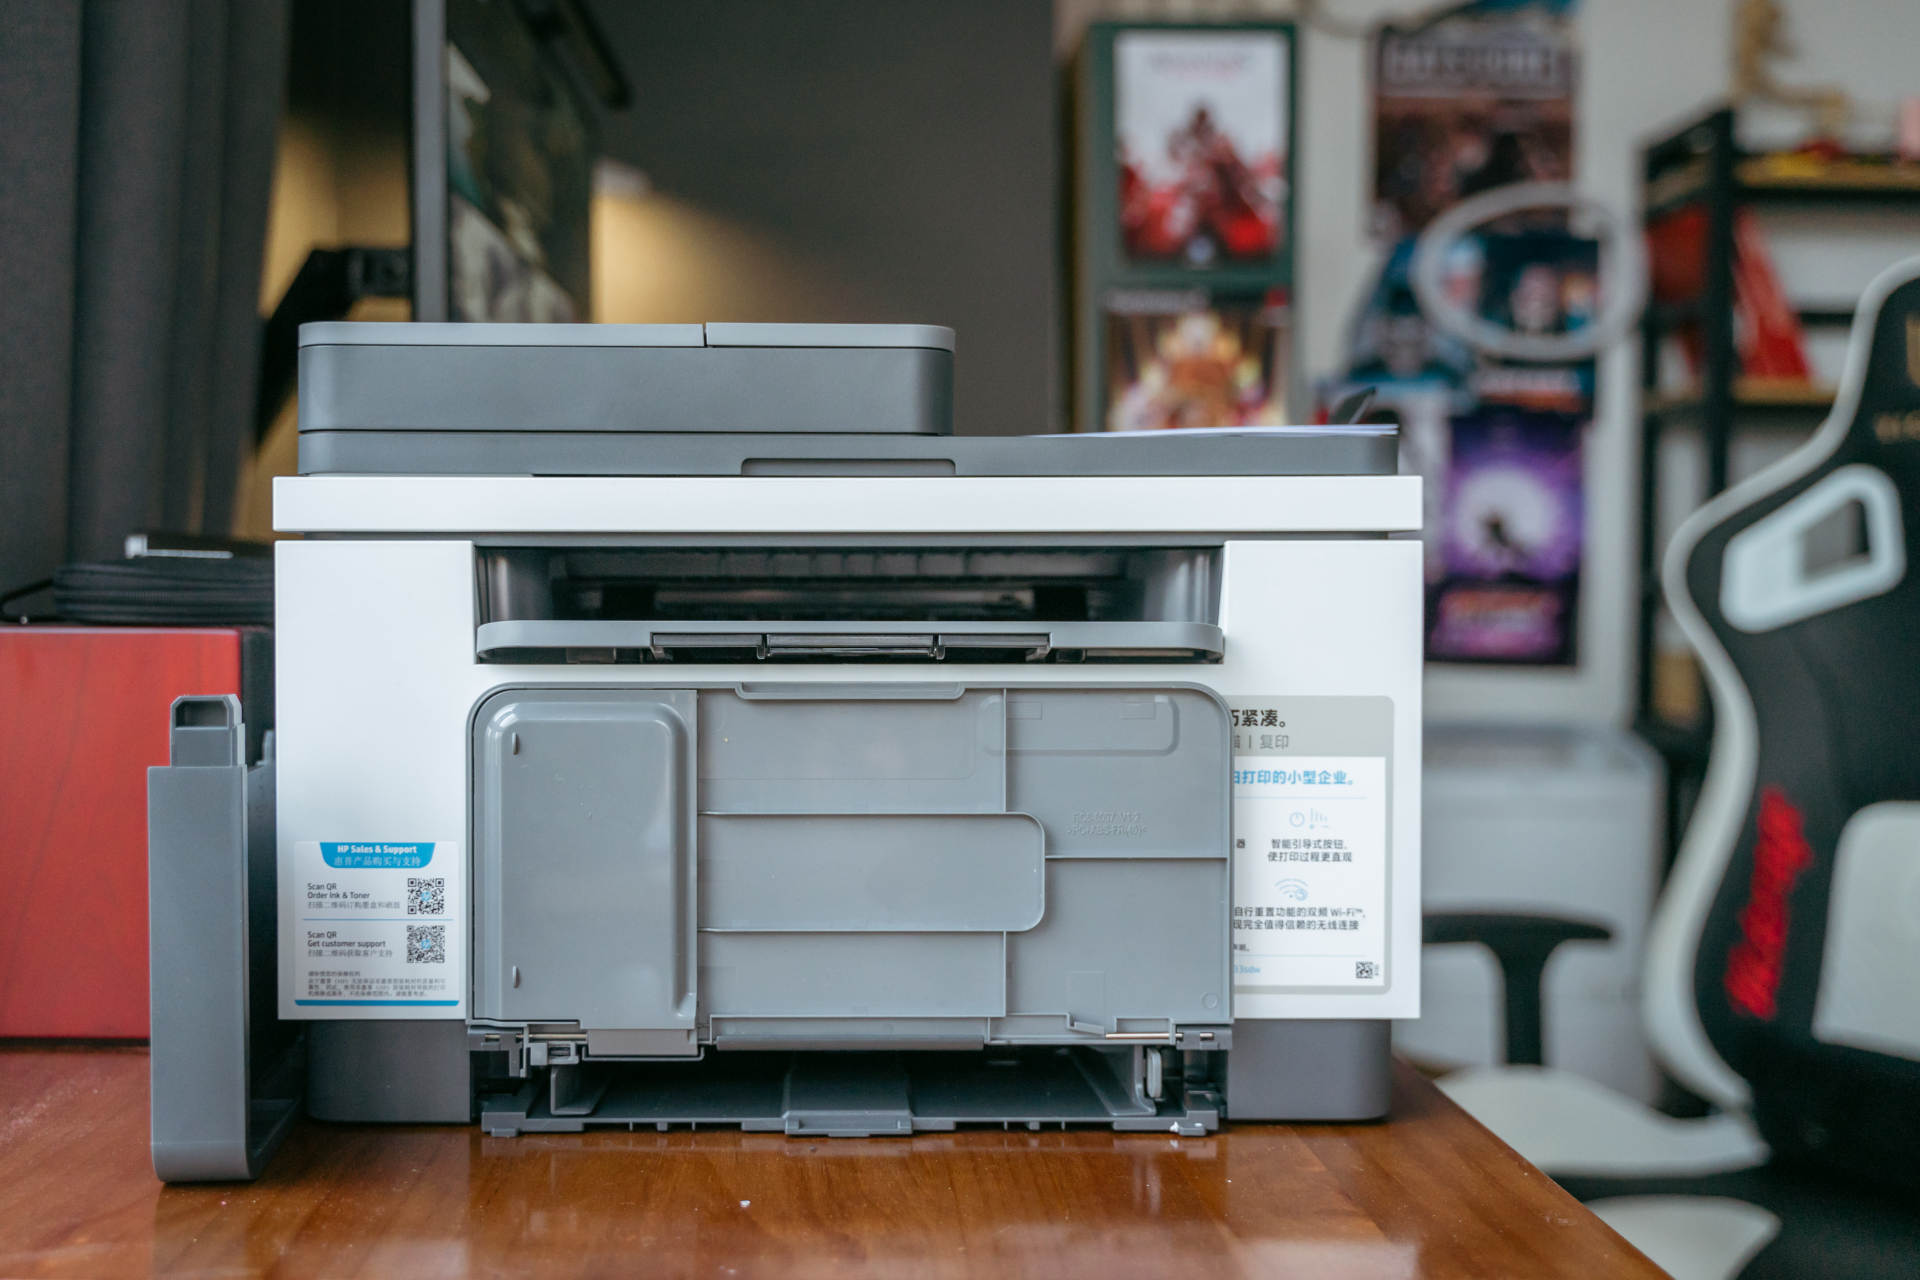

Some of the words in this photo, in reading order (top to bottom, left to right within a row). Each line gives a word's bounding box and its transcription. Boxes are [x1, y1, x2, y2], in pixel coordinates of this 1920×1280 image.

[1259, 734, 1289, 749] 复印
[337, 845, 349, 854] HP
[350, 845, 373, 854] Sales
[374, 845, 382, 854] &
[382, 845, 418, 855] Support
[326, 883, 337, 891] QR
[307, 891, 328, 899] Order
[329, 891, 340, 899] Ink
[341, 891, 348, 899] &
[349, 891, 370, 899] Toner
[326, 931, 337, 939] QR
[307, 940, 320, 948] Get
[321, 940, 356, 948] customer
[357, 940, 386, 949] support
